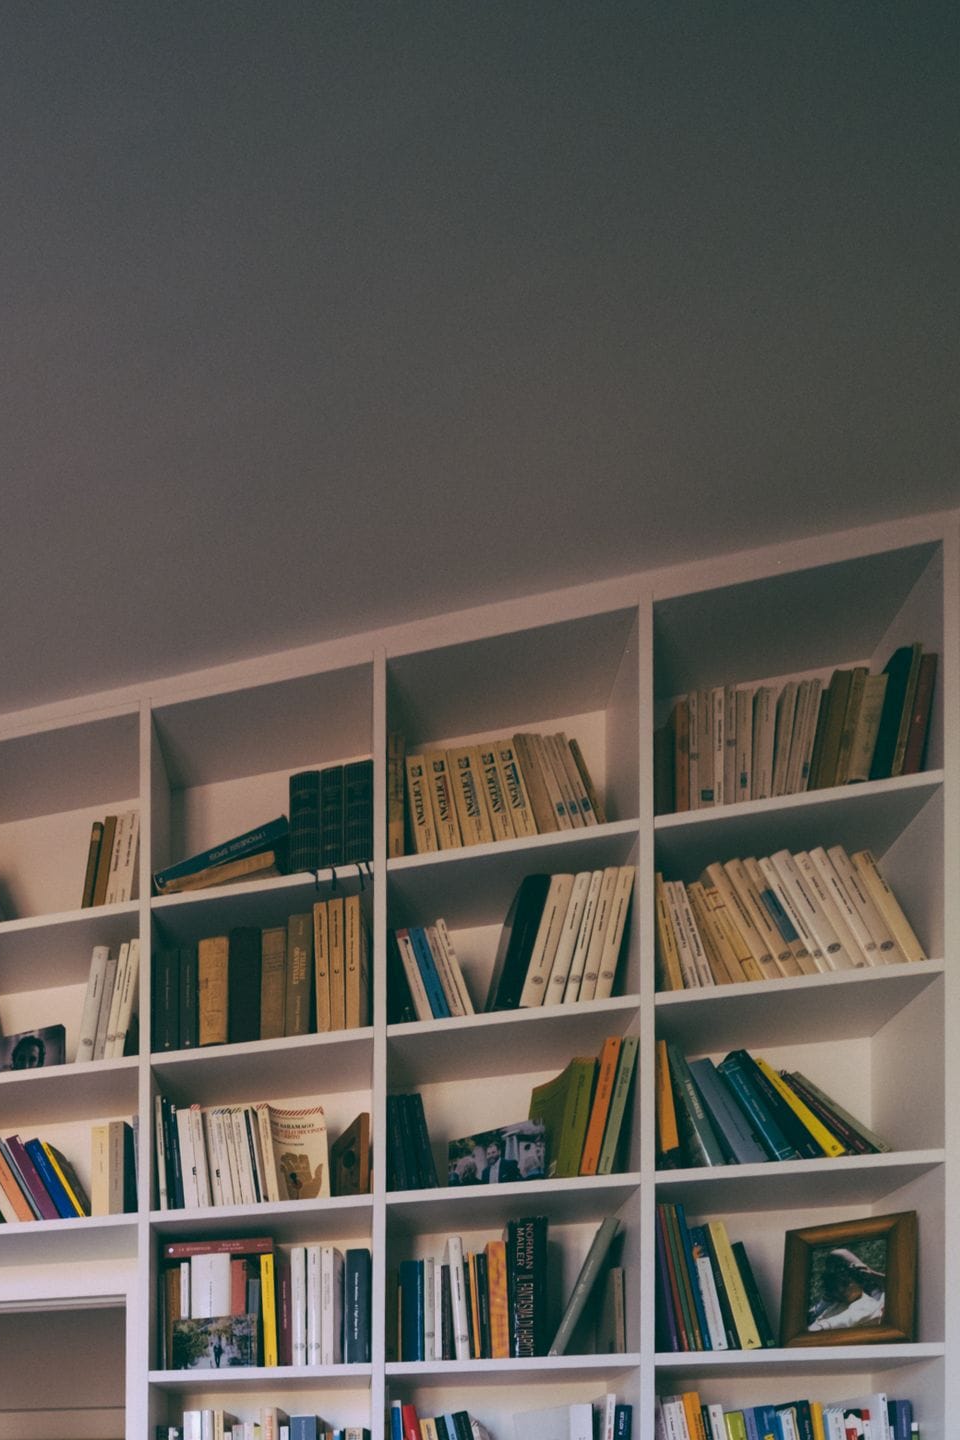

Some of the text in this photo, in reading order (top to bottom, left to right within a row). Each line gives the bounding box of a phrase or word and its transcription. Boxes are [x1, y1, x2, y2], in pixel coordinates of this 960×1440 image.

[412, 779, 426, 827] ANGELICA
[434, 775, 449, 823] ANGELICA
[460, 771, 475, 817] ANGELICA
[484, 766, 501, 813] ANGELICA
[504, 763, 521, 809] ANGELICA
[516, 1228, 525, 1266] MAILER
[525, 1223, 534, 1269] NORMAN
[517, 1282, 534, 1319] FANTASMA
